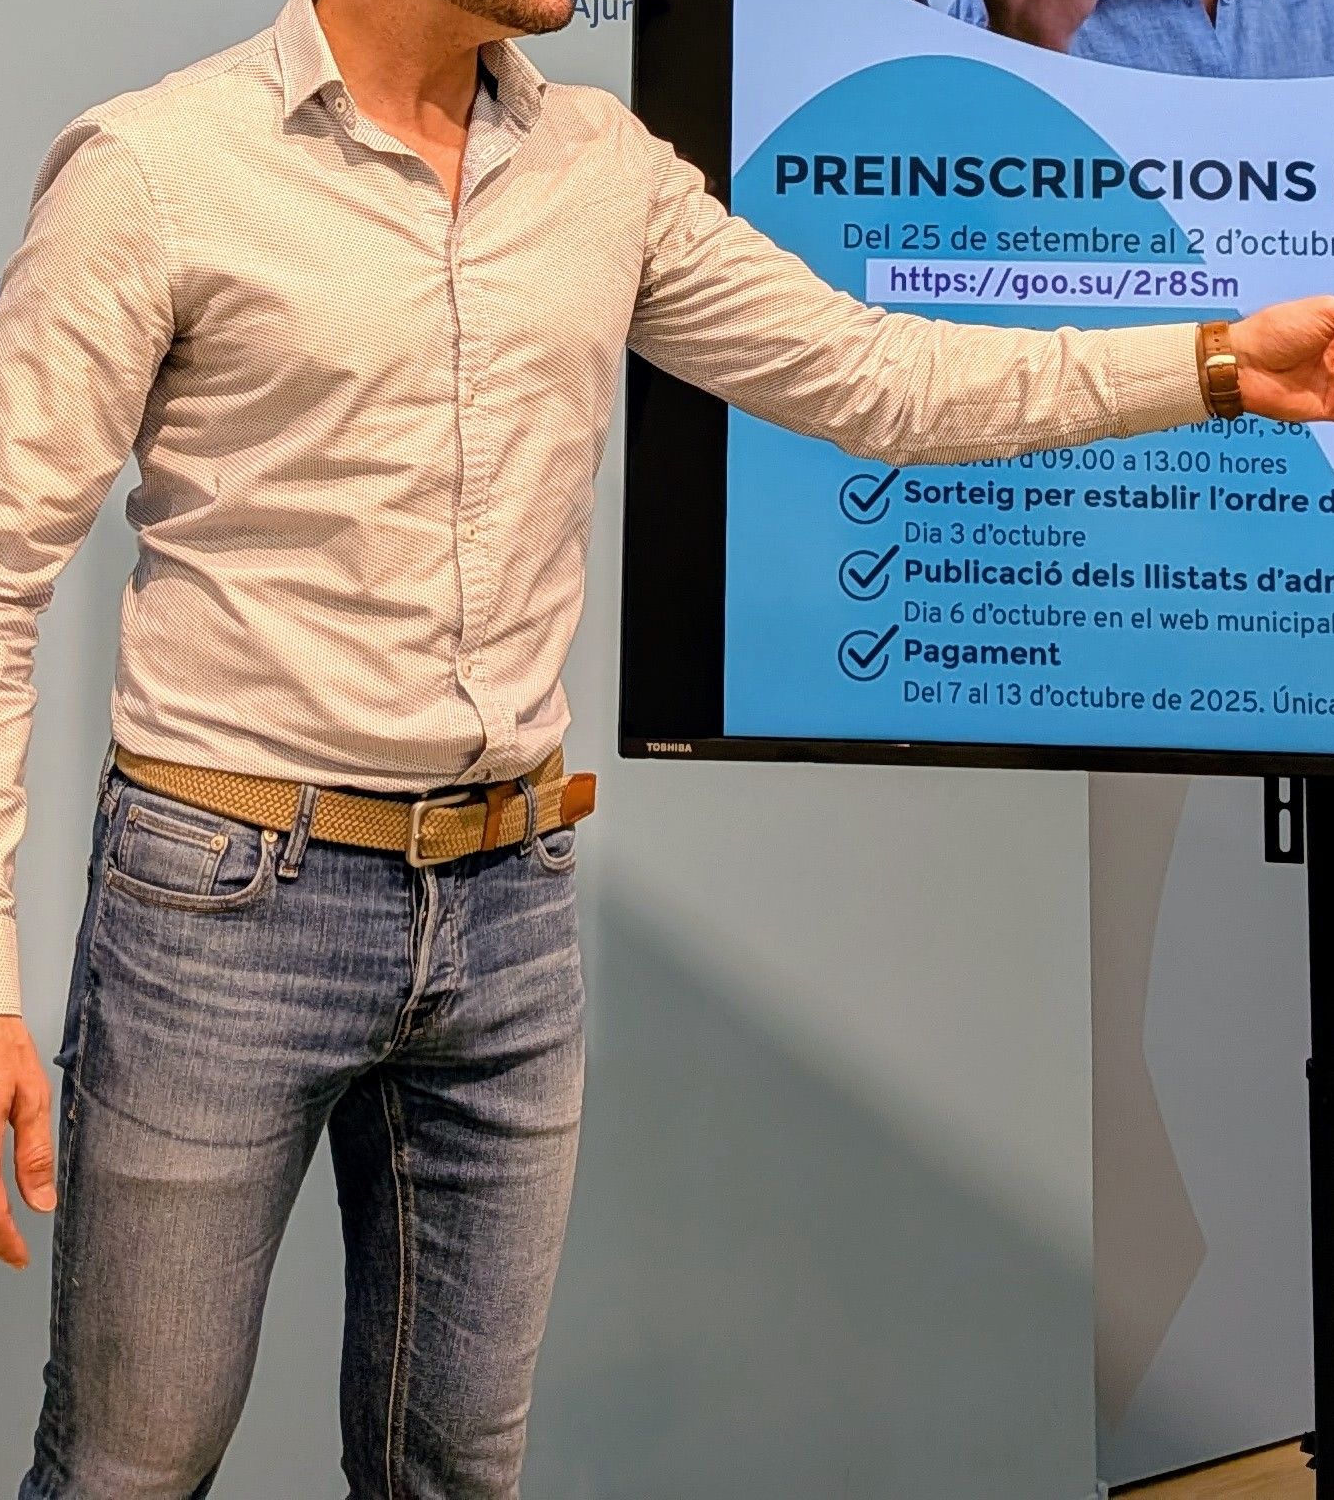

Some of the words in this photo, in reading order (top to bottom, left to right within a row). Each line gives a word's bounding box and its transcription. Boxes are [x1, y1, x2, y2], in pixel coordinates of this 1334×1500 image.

[776, 154, 1317, 201] PREINSCRIPCIONS
[844, 223, 890, 249] Del
[901, 224, 941, 250] 25
[951, 225, 987, 251] de
[997, 226, 1141, 253] setembre
[1150, 229, 1175, 254] al
[1186, 229, 1205, 254] 2
[890, 265, 1239, 299] https://goo.su/2r8Sm
[1123, 454, 1136, 471] a
[1144, 450, 1211, 472] 13.00
[1220, 452, 1287, 475] hores
[904, 479, 1014, 511] Sorteig
[1025, 485, 1075, 511] per
[1084, 485, 1201, 510] establir
[1210, 486, 1309, 512] l'ordre
[905, 521, 942, 544] Dia
[950, 522, 965, 544] 3
[972, 523, 1086, 547] d'octubre
[905, 559, 1063, 586] Publicació
[1072, 562, 1135, 588] dels
[1144, 564, 1248, 591] llistats
[905, 601, 942, 624] Dia
[950, 602, 965, 624] 6
[972, 602, 1086, 627] d'octubre
[1094, 610, 1123, 628] en
[1131, 608, 1152, 629] el
[1160, 609, 1209, 631] web
[904, 639, 1062, 669] Pagament
[904, 681, 942, 703] Del
[948, 682, 962, 703] 7
[969, 682, 988, 704] al
[996, 683, 1022, 705] 13
[1030, 684, 1145, 709] d'octubre
[1152, 688, 1182, 711] de
[1190, 689, 1265, 713] 2025.
[646, 742, 693, 753] TOSHIBA
